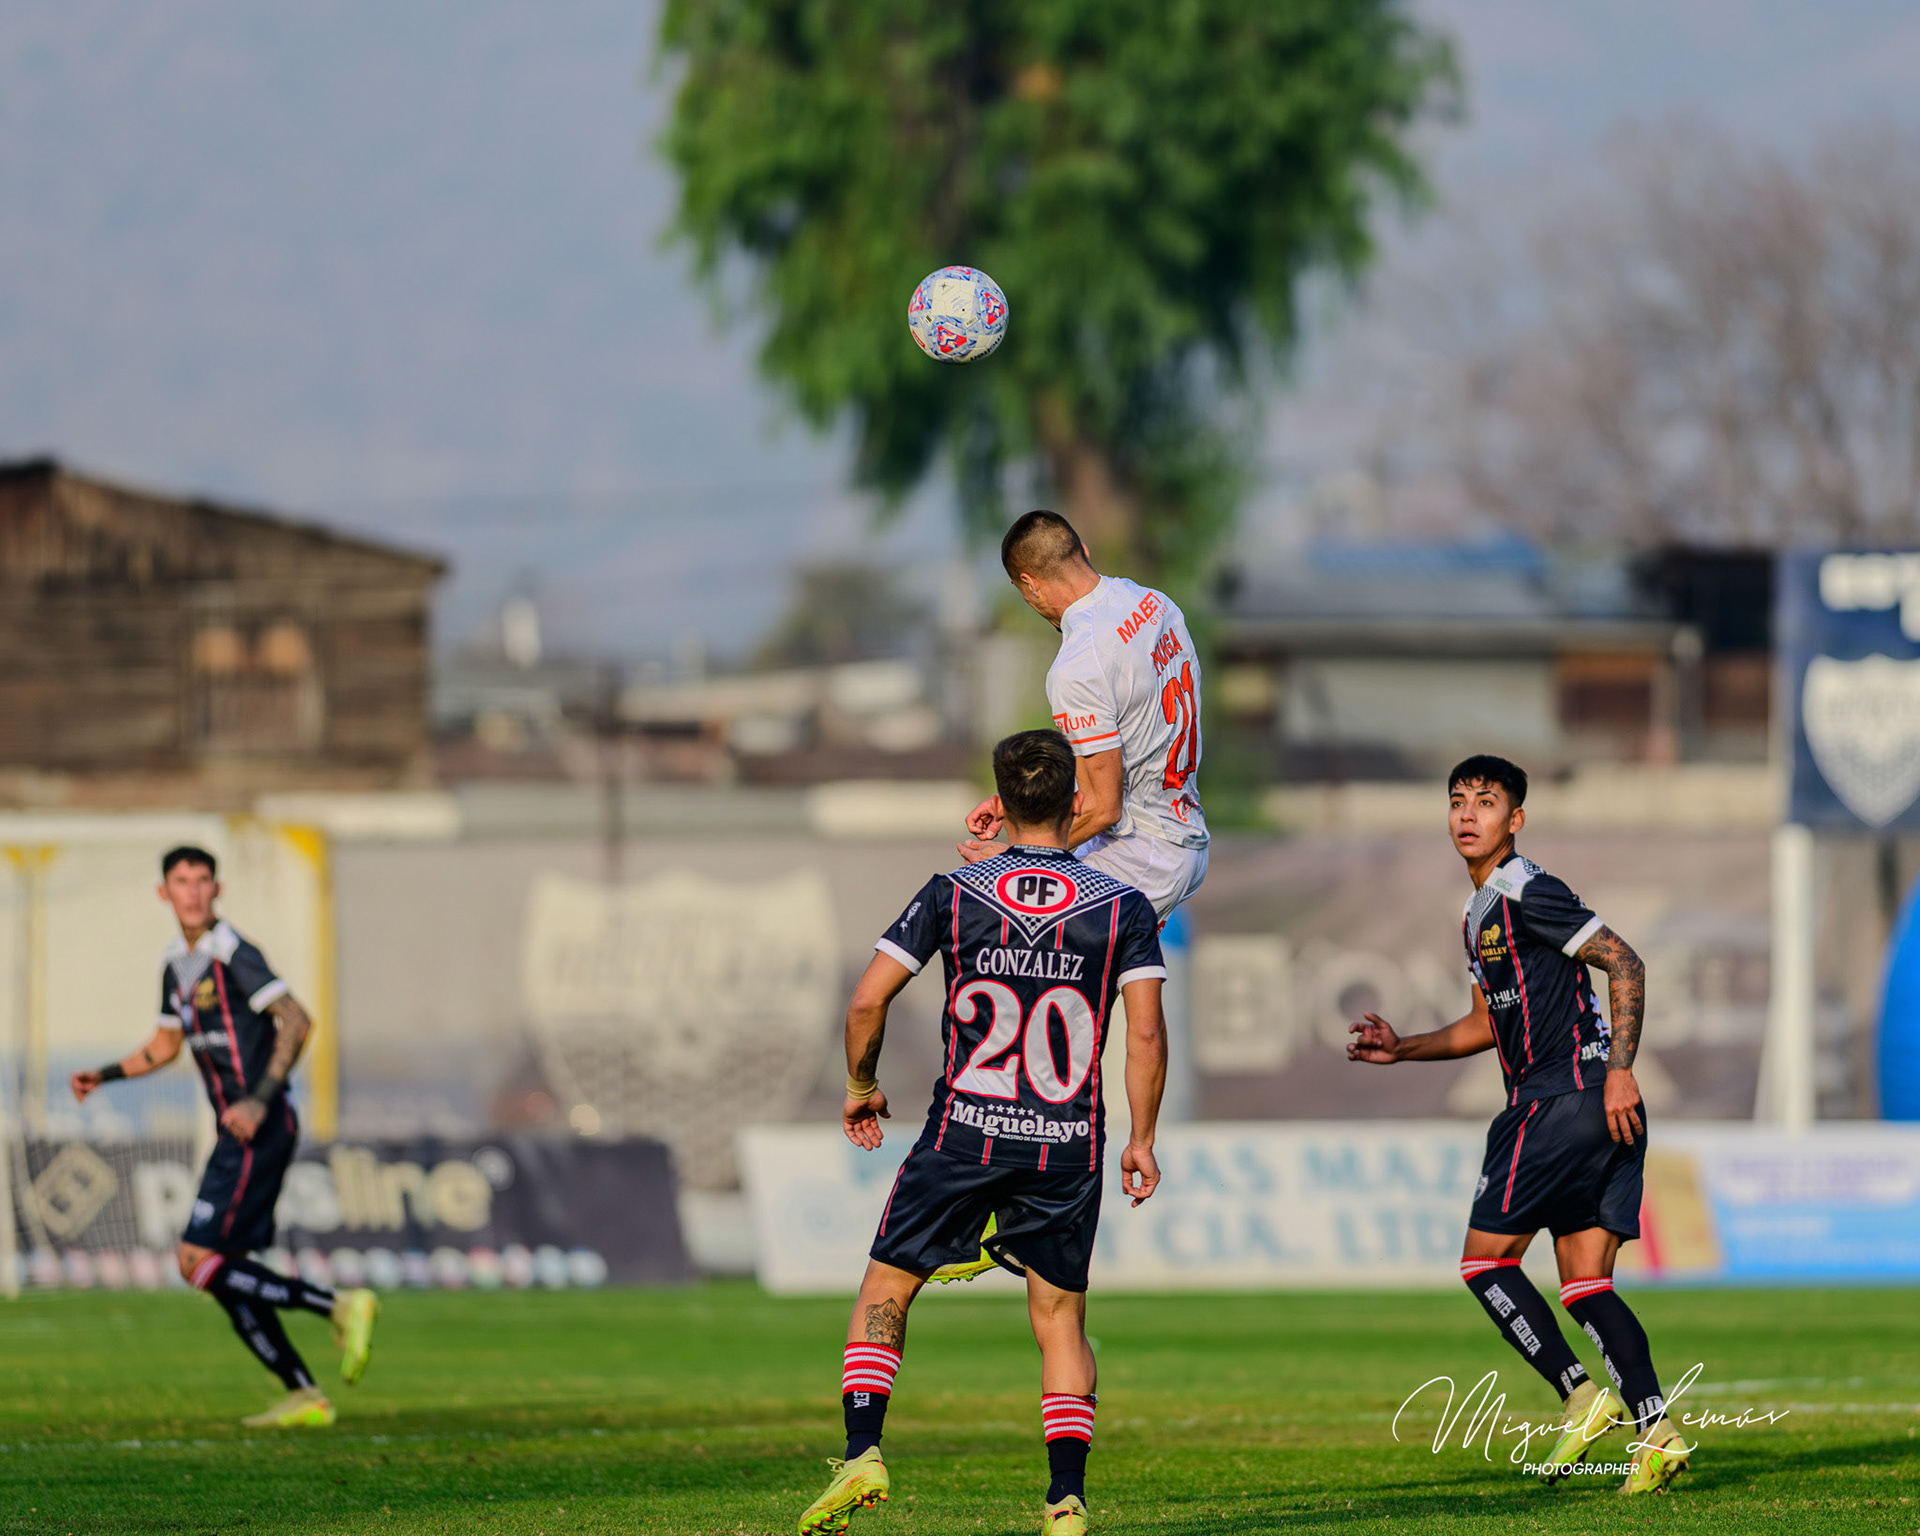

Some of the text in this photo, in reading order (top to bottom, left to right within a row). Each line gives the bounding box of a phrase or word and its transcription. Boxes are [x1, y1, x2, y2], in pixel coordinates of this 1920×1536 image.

[1117, 591, 1162, 644] MABET
[1162, 660, 1197, 791] 21
[1016, 875, 1059, 906] PF
[976, 947, 1085, 981] GONZALEZ
[1493, 988, 1520, 1004] HILL
[951, 979, 1097, 1104] 20
[950, 1100, 1090, 1143] Miguelayo
[999, 1133, 1024, 1141] MAESTRO
[1031, 1135, 1059, 1144] MAESTROS
[1484, 1283, 1541, 1356] DEPORTES RECOLETA
